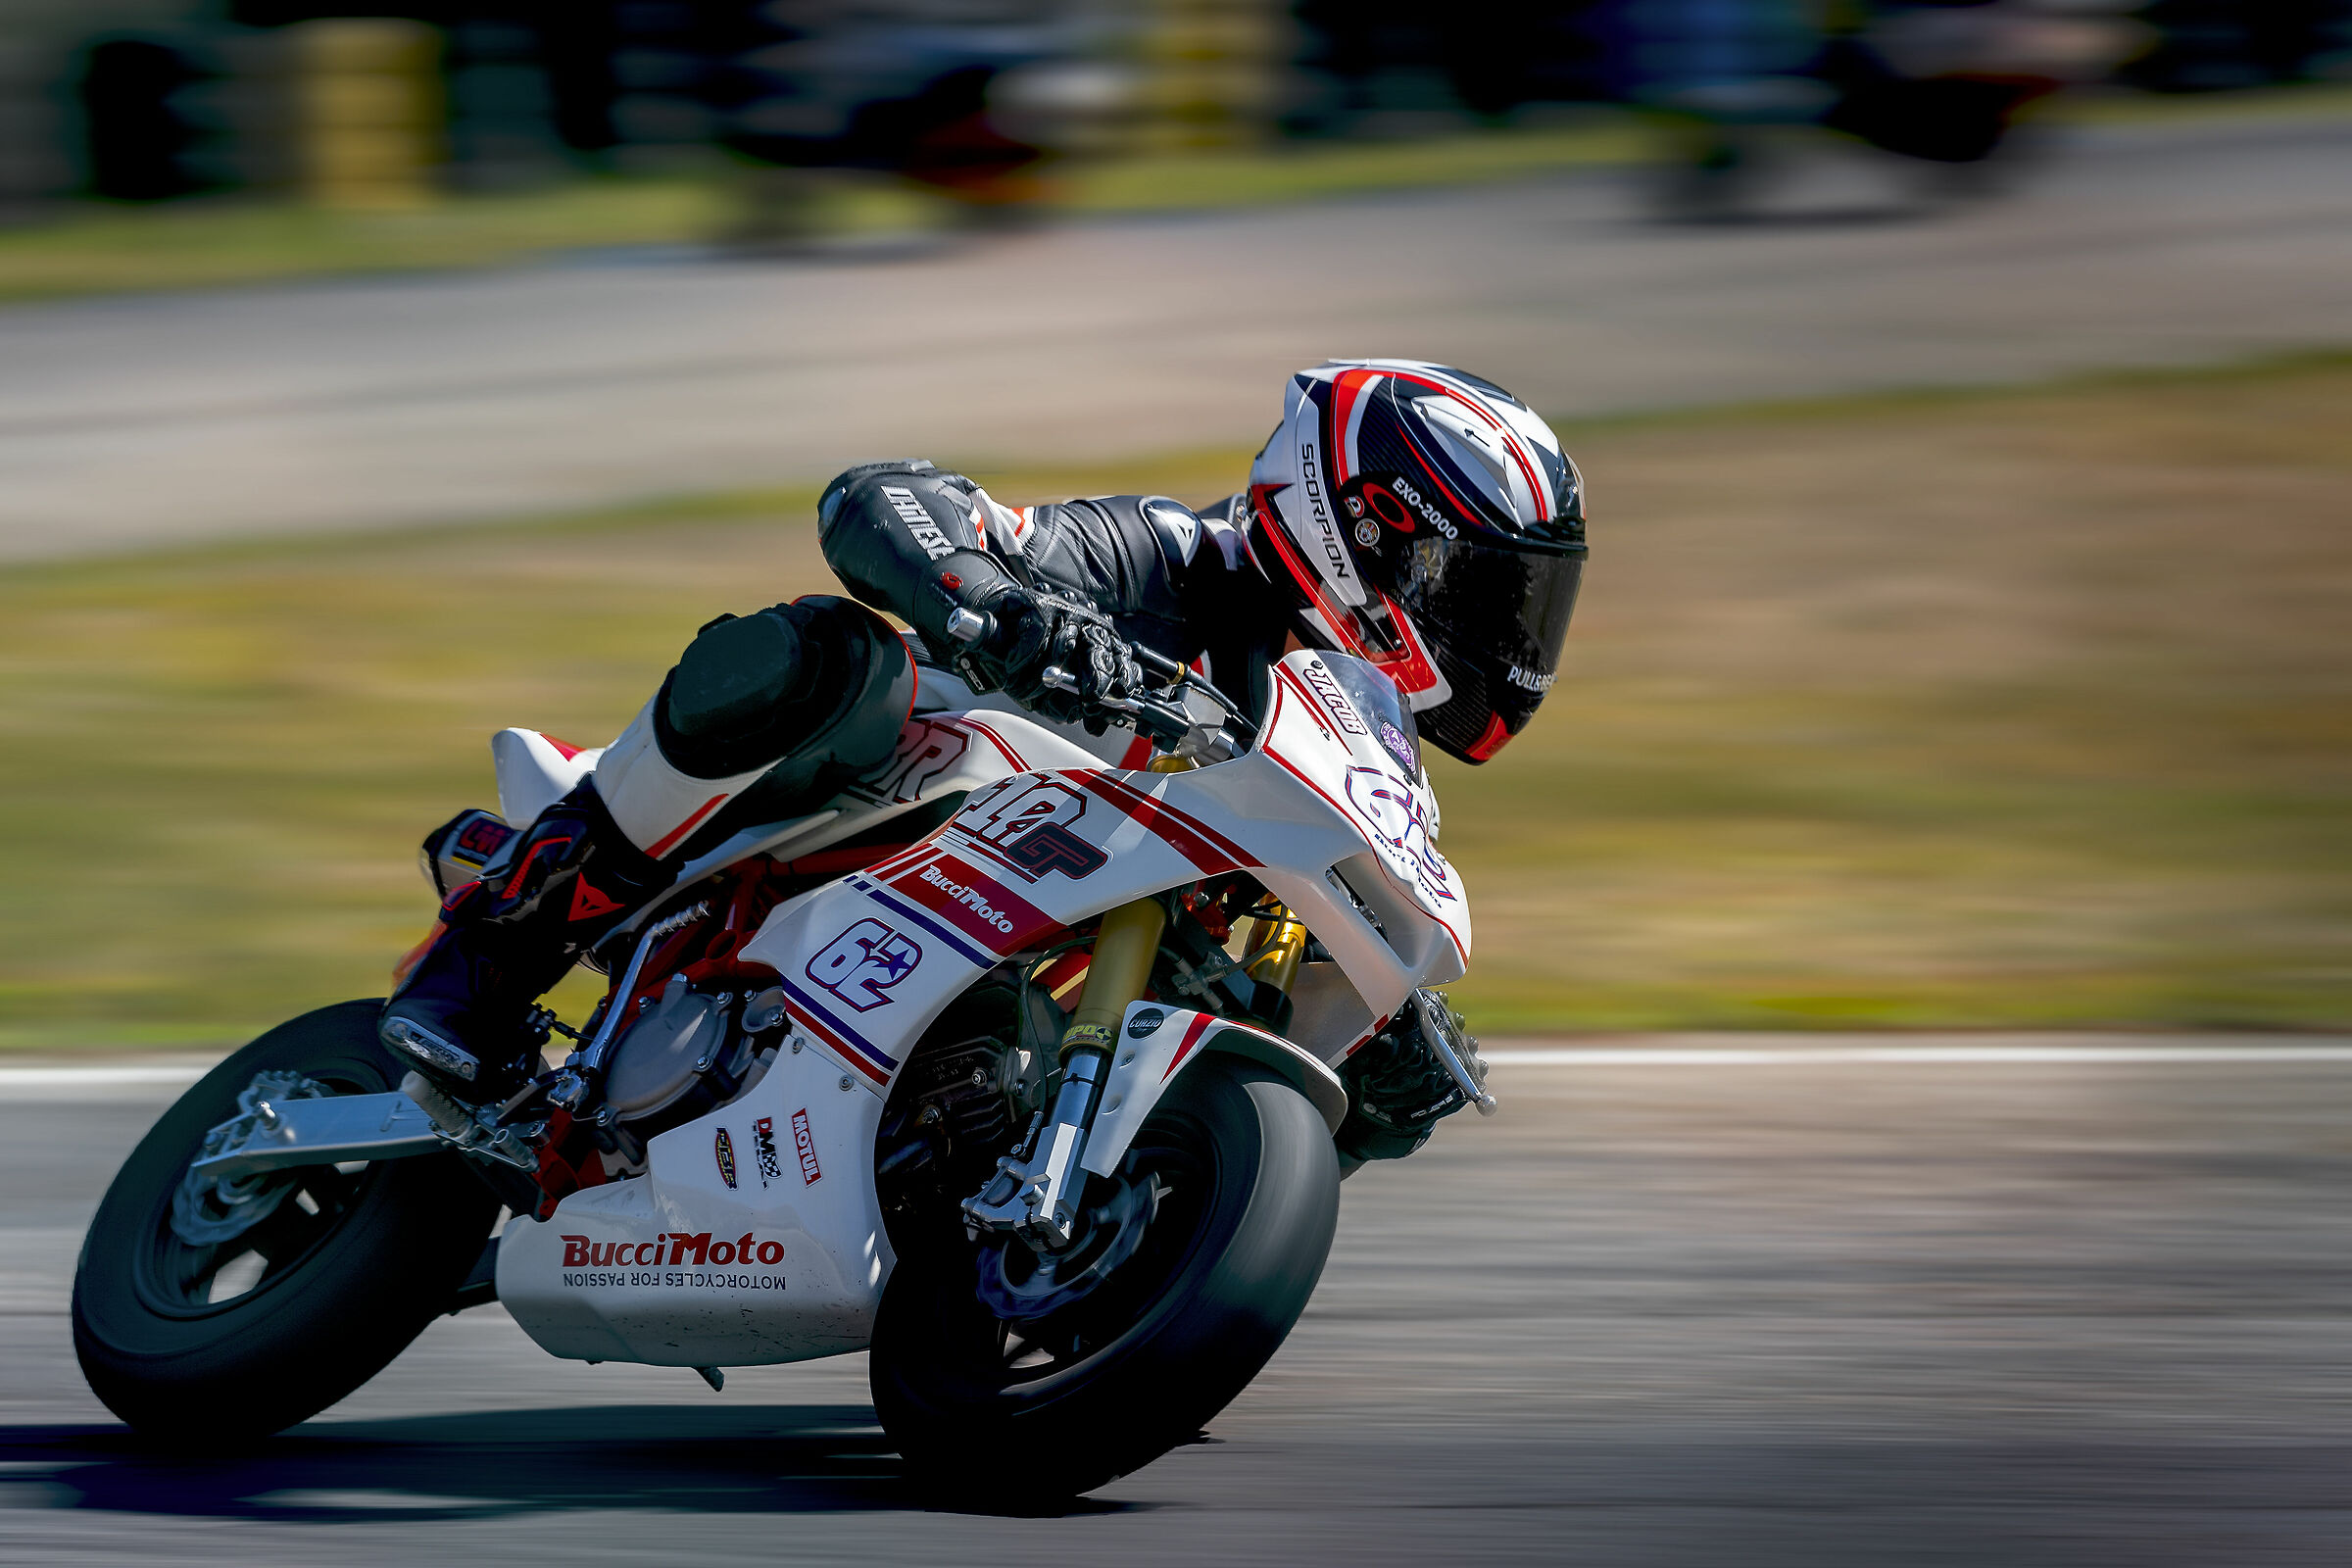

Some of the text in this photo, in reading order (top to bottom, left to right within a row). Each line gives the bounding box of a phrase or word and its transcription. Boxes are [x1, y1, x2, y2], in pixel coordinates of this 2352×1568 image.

[1300, 442, 1350, 580] SCORPION
[1392, 476, 1458, 540] EXO-2000
[1303, 667, 1367, 736] JACOB
[1003, 821, 1109, 880] GP
[919, 864, 1013, 933] BucciMoto
[806, 917, 923, 1013] 62
[793, 1115, 817, 1181] MOTUL
[560, 1232, 785, 1267] BucciMoto
[564, 1272, 786, 1291] MOTORCYCLES FOR PASSION
